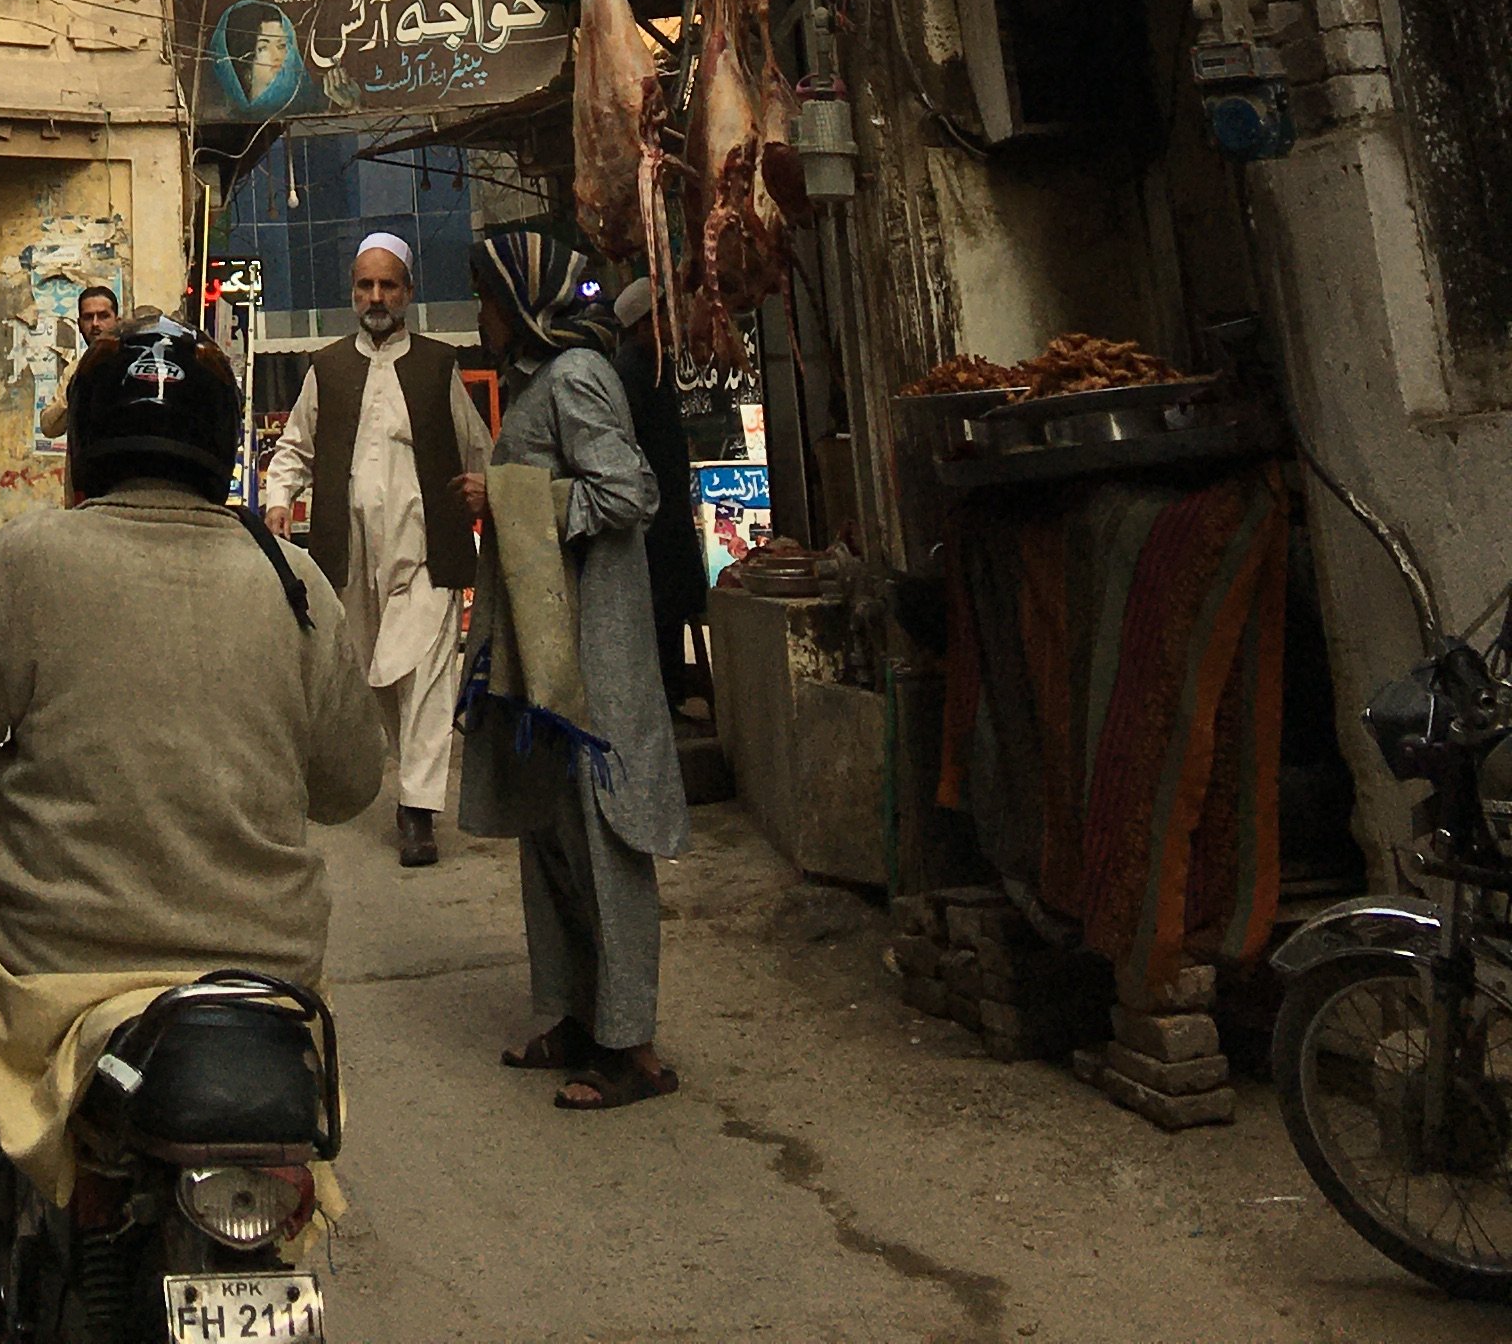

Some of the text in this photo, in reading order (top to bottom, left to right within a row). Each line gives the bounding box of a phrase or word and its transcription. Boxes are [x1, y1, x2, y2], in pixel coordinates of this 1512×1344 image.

[133, 364, 180, 379] TECH
[221, 1280, 263, 1297] KPK
[177, 1303, 315, 1340] FH 2111
